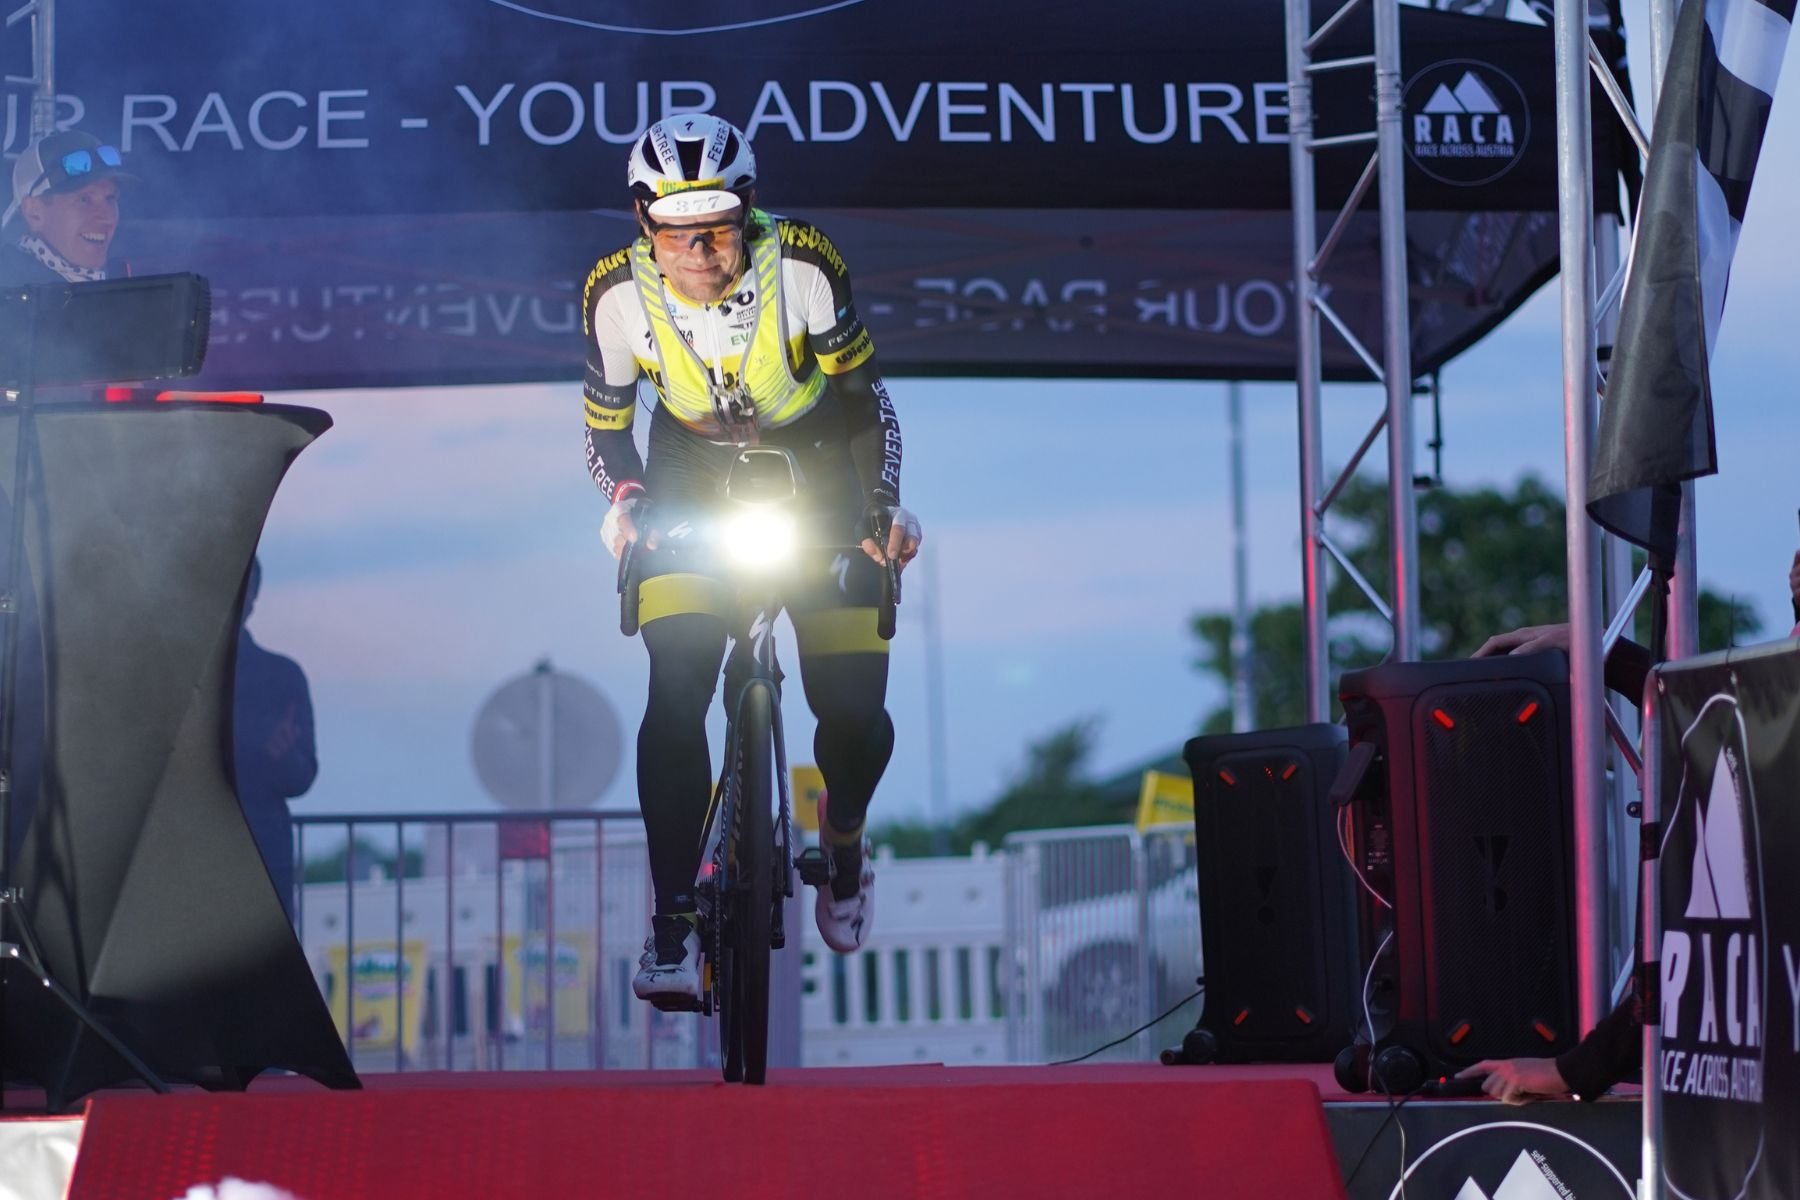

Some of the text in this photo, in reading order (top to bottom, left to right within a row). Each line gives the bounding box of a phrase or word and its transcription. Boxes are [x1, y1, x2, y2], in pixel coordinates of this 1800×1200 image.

[121, 89, 370, 153] RACE
[455, 81, 717, 146] YOUR
[744, 80, 1290, 144] ADVENTURE
[1413, 114, 1515, 144] RACA
[675, 195, 721, 214] 377
[1660, 930, 1762, 1048] RACA
[1682, 1053, 1729, 1098] ACROSS
